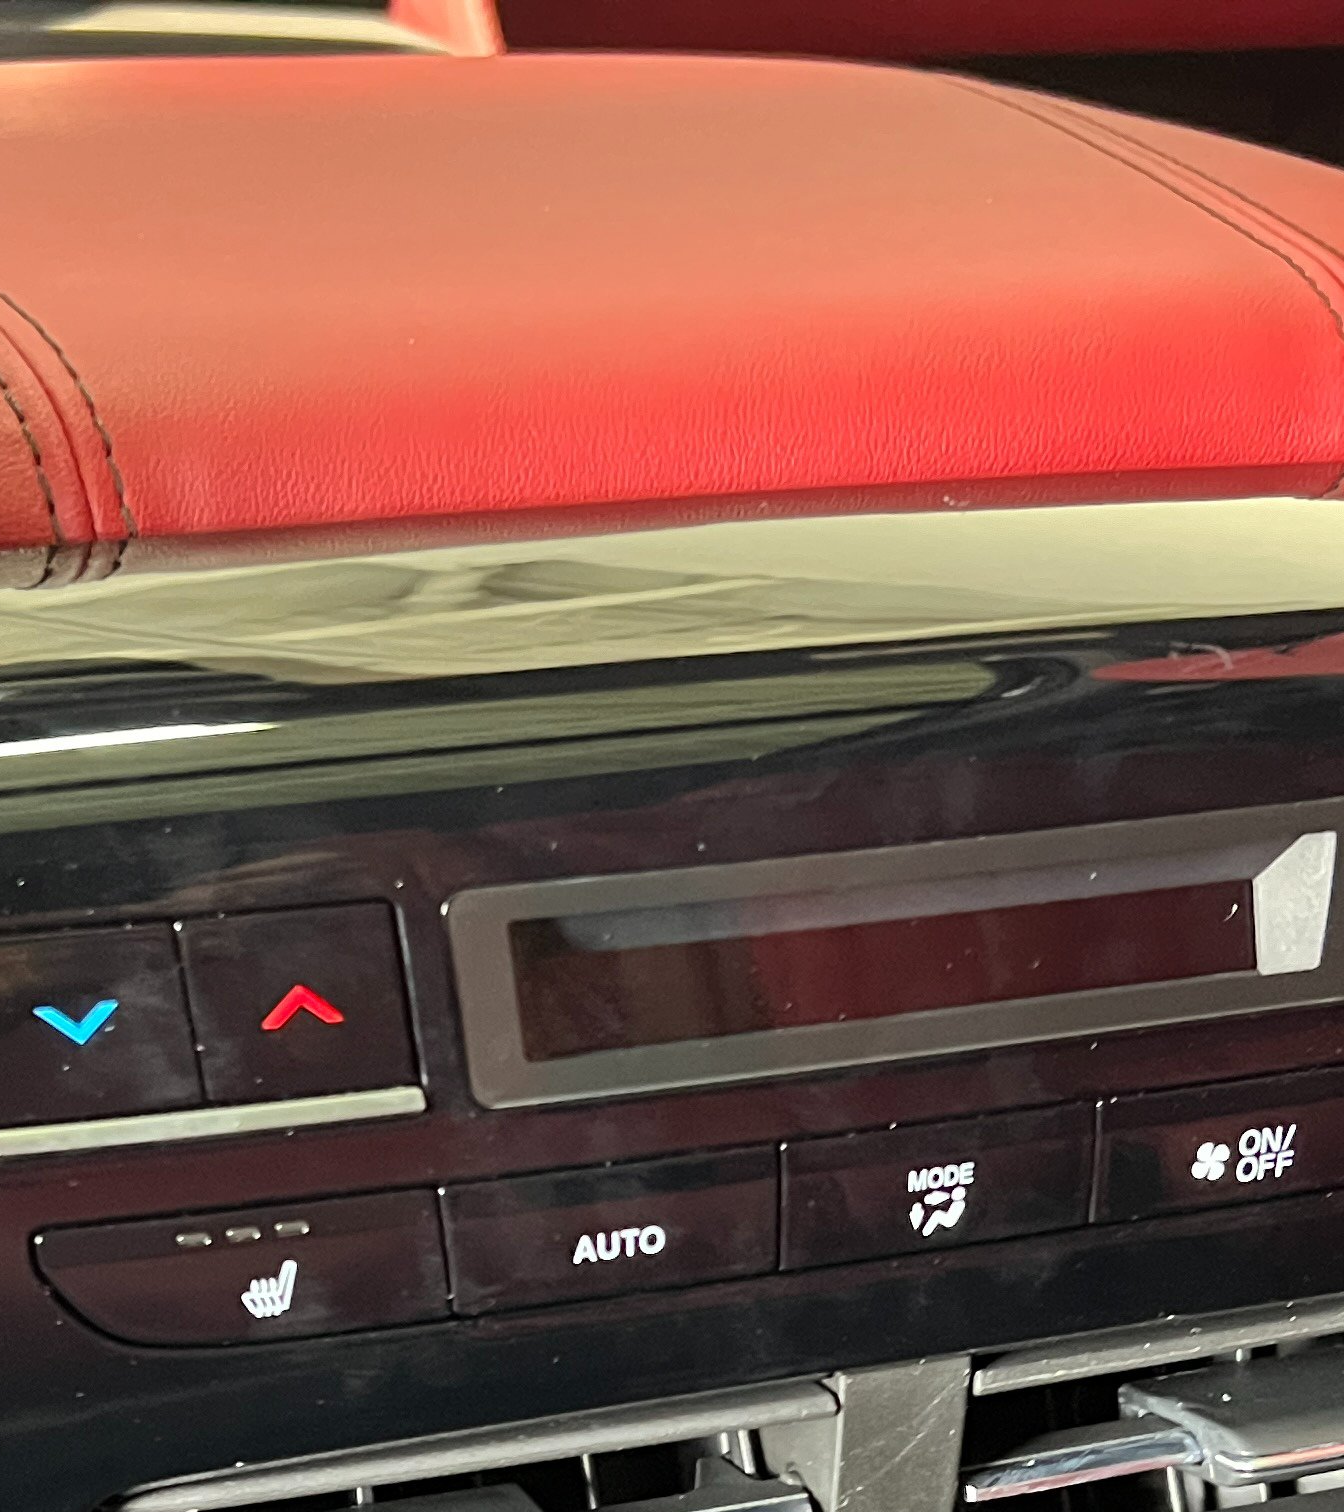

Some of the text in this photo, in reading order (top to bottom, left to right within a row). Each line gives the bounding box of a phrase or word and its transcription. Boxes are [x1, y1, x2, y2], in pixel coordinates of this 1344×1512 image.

[1238, 1123, 1297, 1157] ON/
[907, 1161, 975, 1193] MODE
[1235, 1149, 1295, 1183] OFF
[572, 1225, 666, 1265] AUTO
